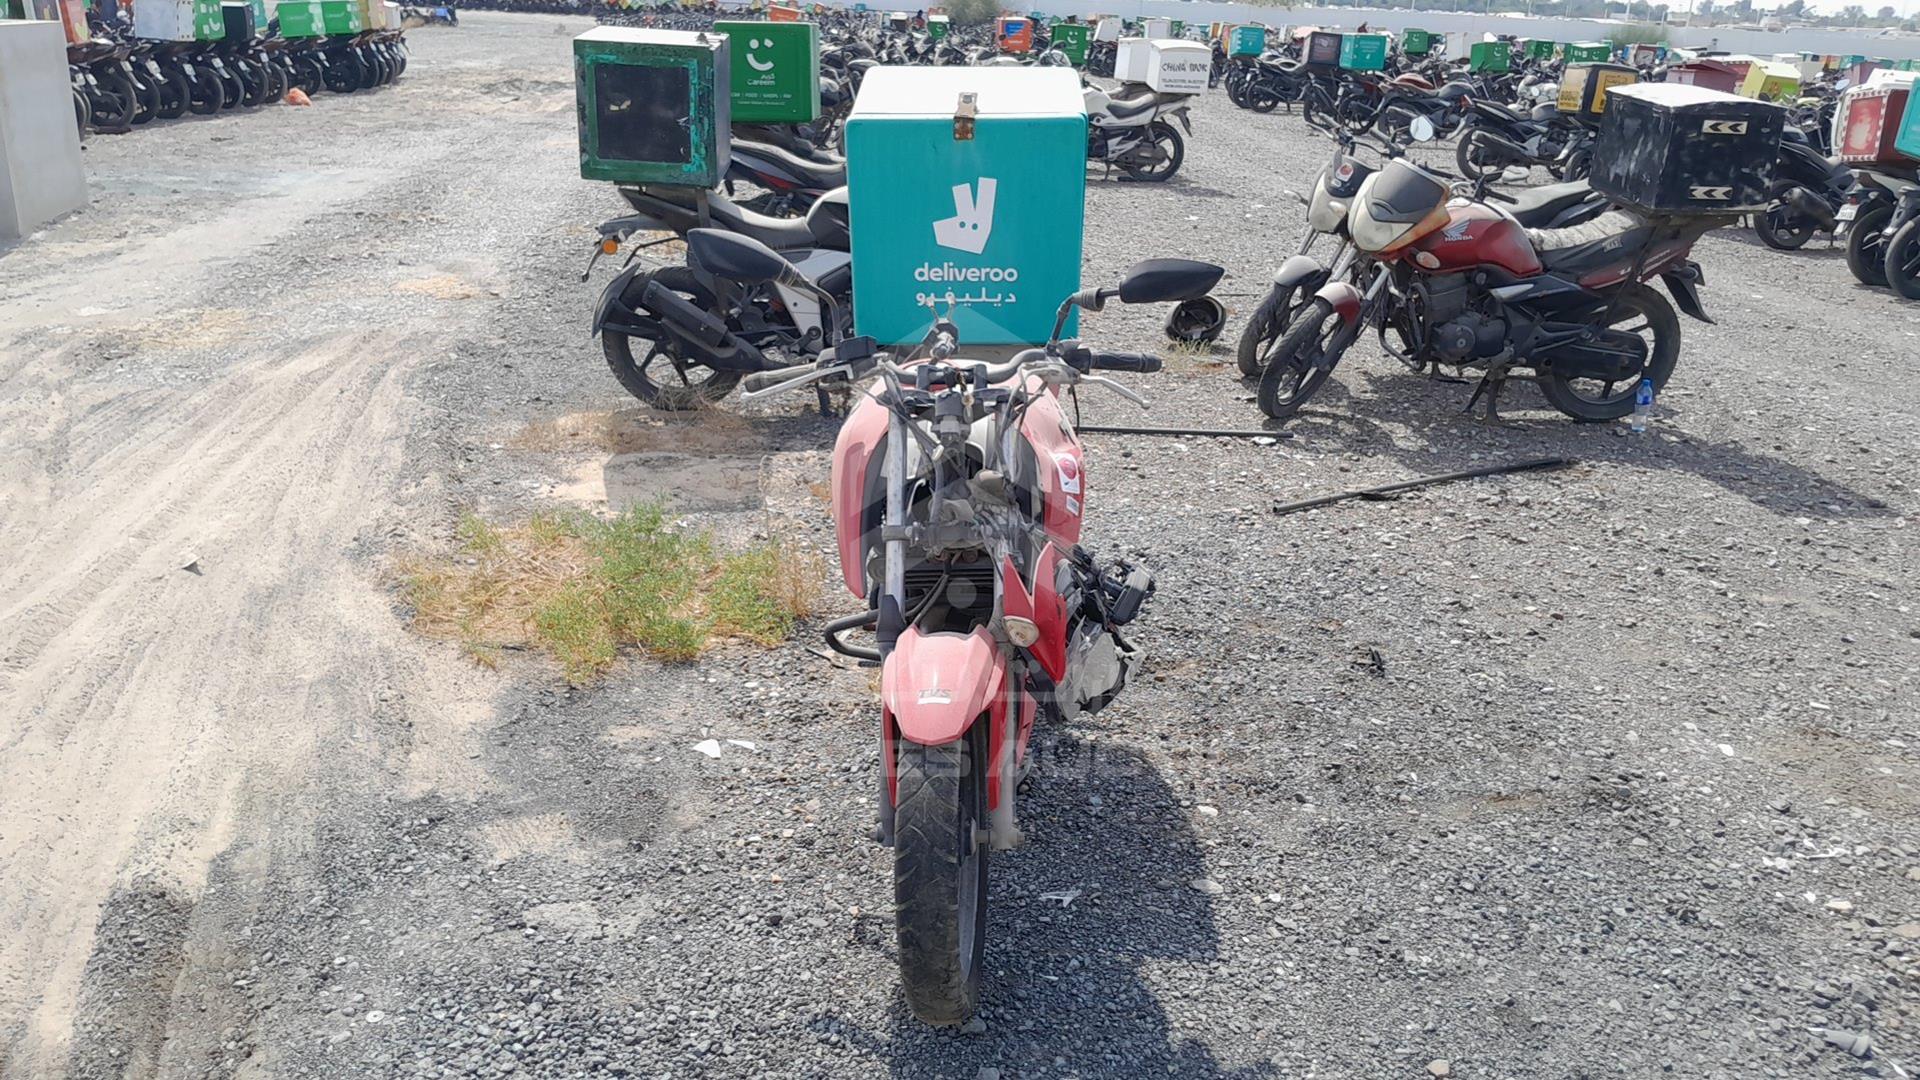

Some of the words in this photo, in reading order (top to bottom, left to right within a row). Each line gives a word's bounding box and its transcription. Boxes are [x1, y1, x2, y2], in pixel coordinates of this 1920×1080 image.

[746, 78, 776, 86] Careem
[1444, 234, 1474, 242] HONDA
[914, 262, 1018, 282] deliveroo
[919, 688, 952, 698] TVS
